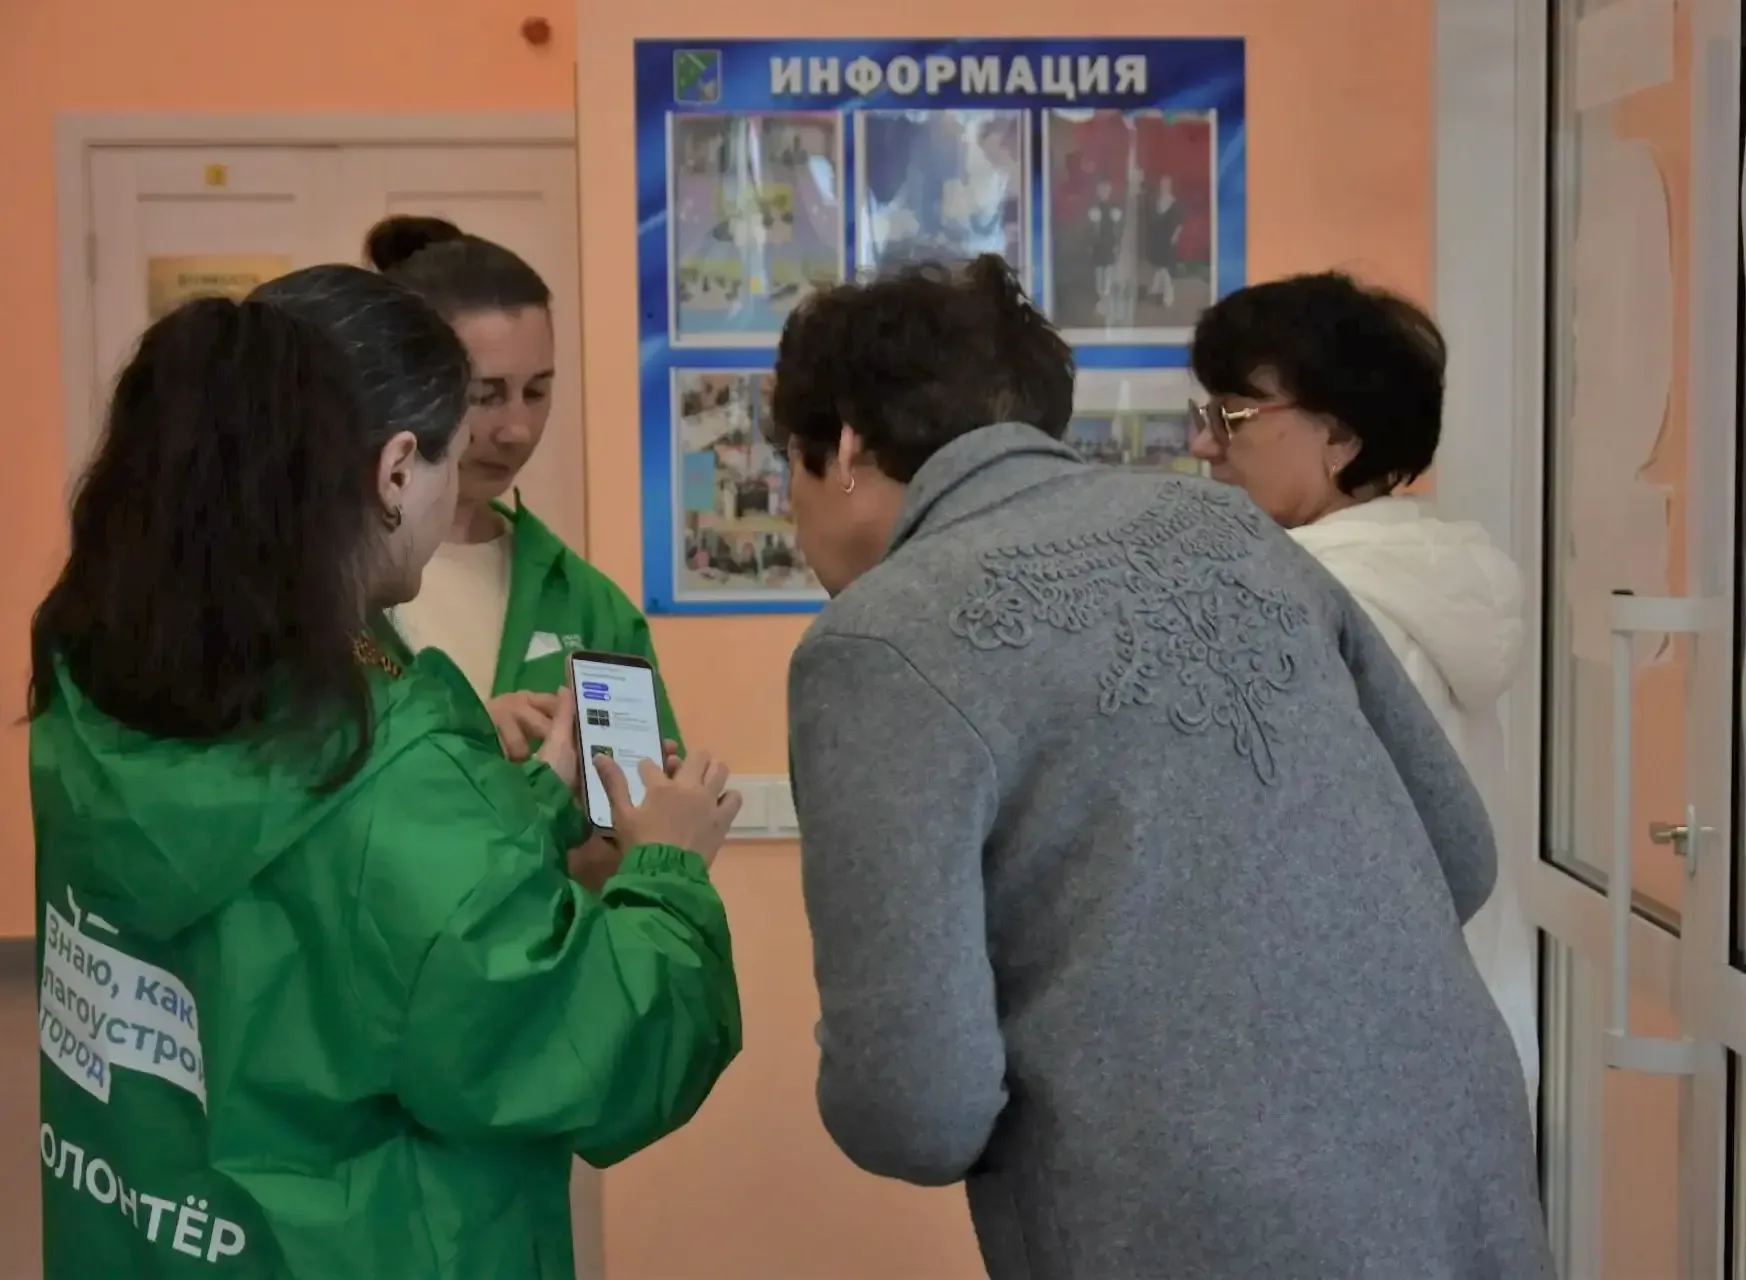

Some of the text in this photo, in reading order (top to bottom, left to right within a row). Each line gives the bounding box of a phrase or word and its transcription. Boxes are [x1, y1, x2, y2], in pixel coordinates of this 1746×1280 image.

[769, 55, 1147, 100] ИНФОРМАЦИЯ
[43, 965, 205, 1083] лагоустро
[48, 912, 196, 1031] Знаю, как
[41, 1007, 106, 1089] город
[40, 1122, 246, 1264] ОЛОНТЁР
